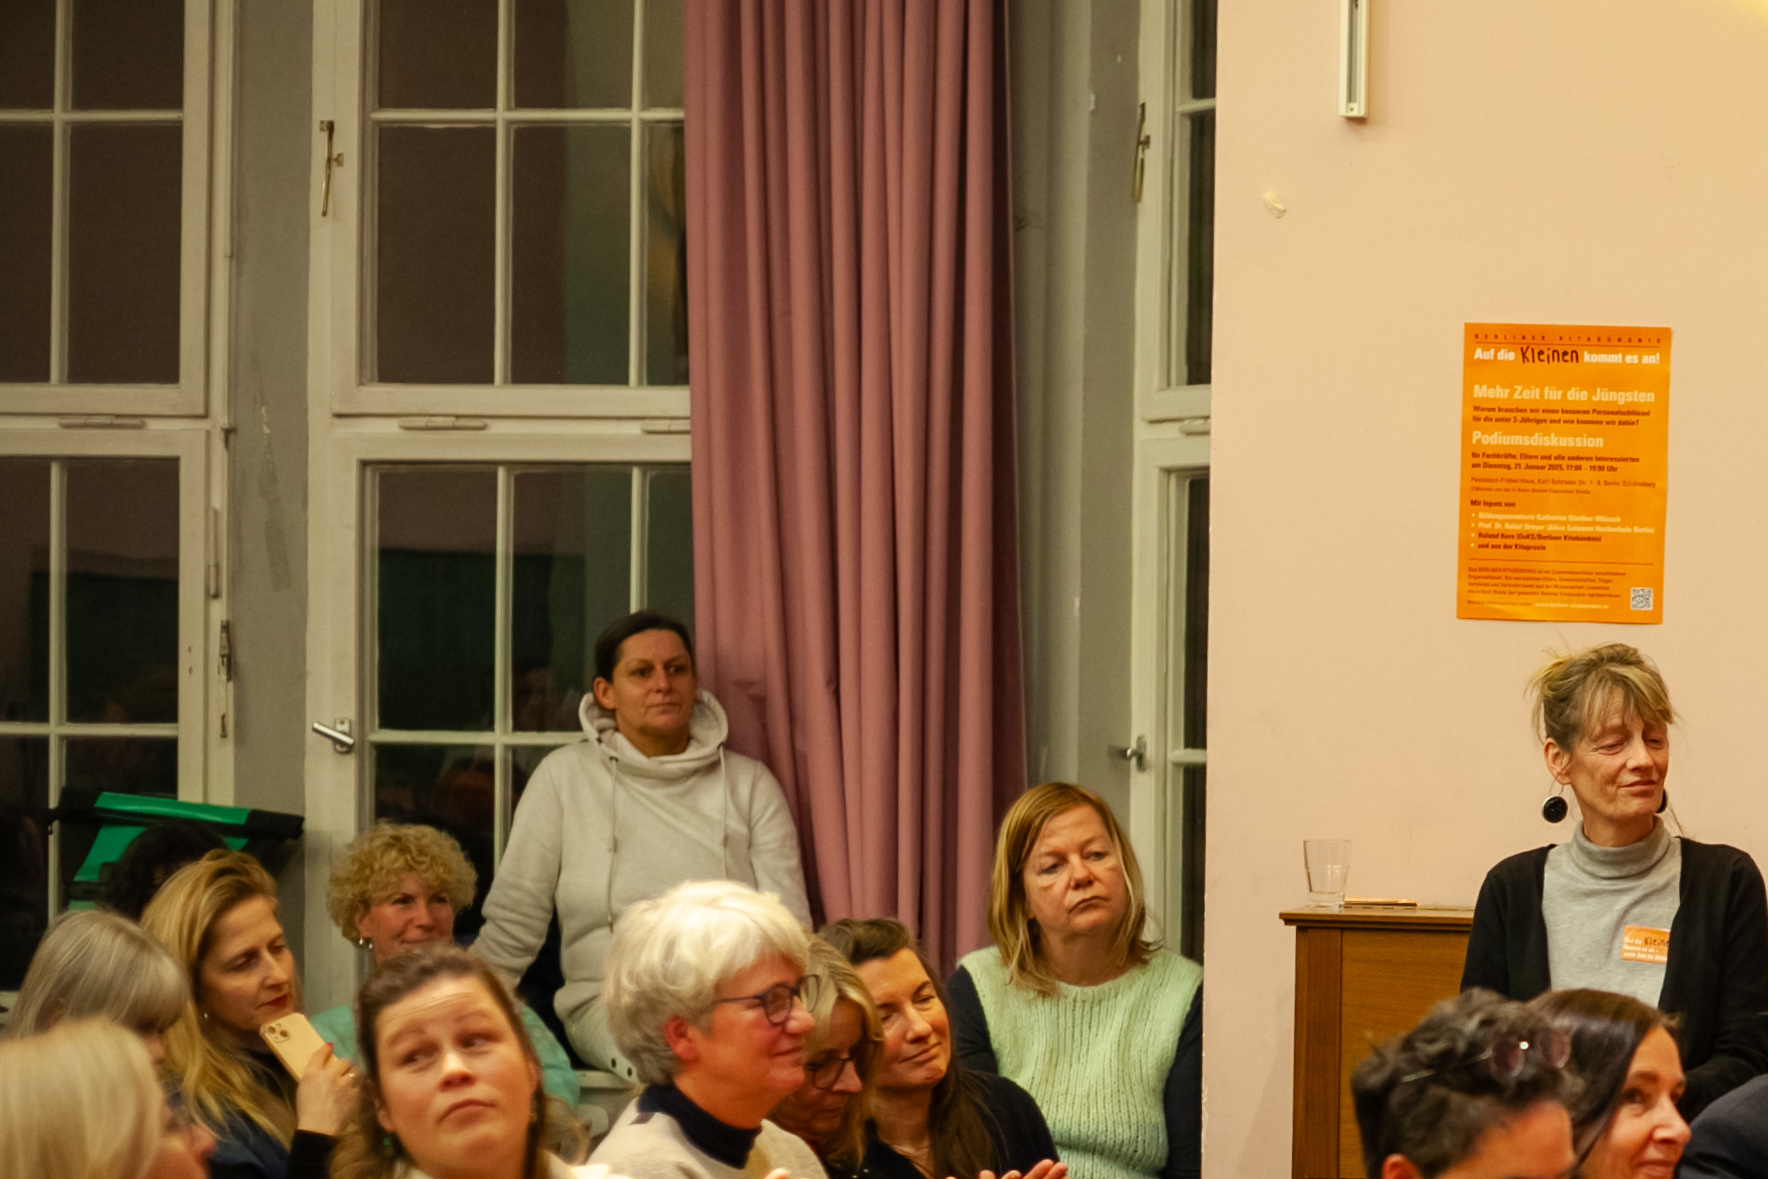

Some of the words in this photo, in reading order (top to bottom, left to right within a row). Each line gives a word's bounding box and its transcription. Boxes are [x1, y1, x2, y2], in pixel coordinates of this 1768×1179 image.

[1473, 347, 1496, 360] Auf
[1496, 348, 1516, 361] die
[1520, 345, 1579, 364] Kleinen
[1583, 350, 1623, 364] kommt
[1625, 354, 1639, 364] es
[1641, 352, 1660, 365] an!
[1473, 384, 1510, 399] Mehr
[1513, 385, 1541, 400] Zeit
[1543, 386, 1564, 400] für
[1566, 387, 1588, 401] die
[1592, 387, 1655, 405] Jüngsten
[1472, 430, 1604, 447] Podiumsdiskussion
